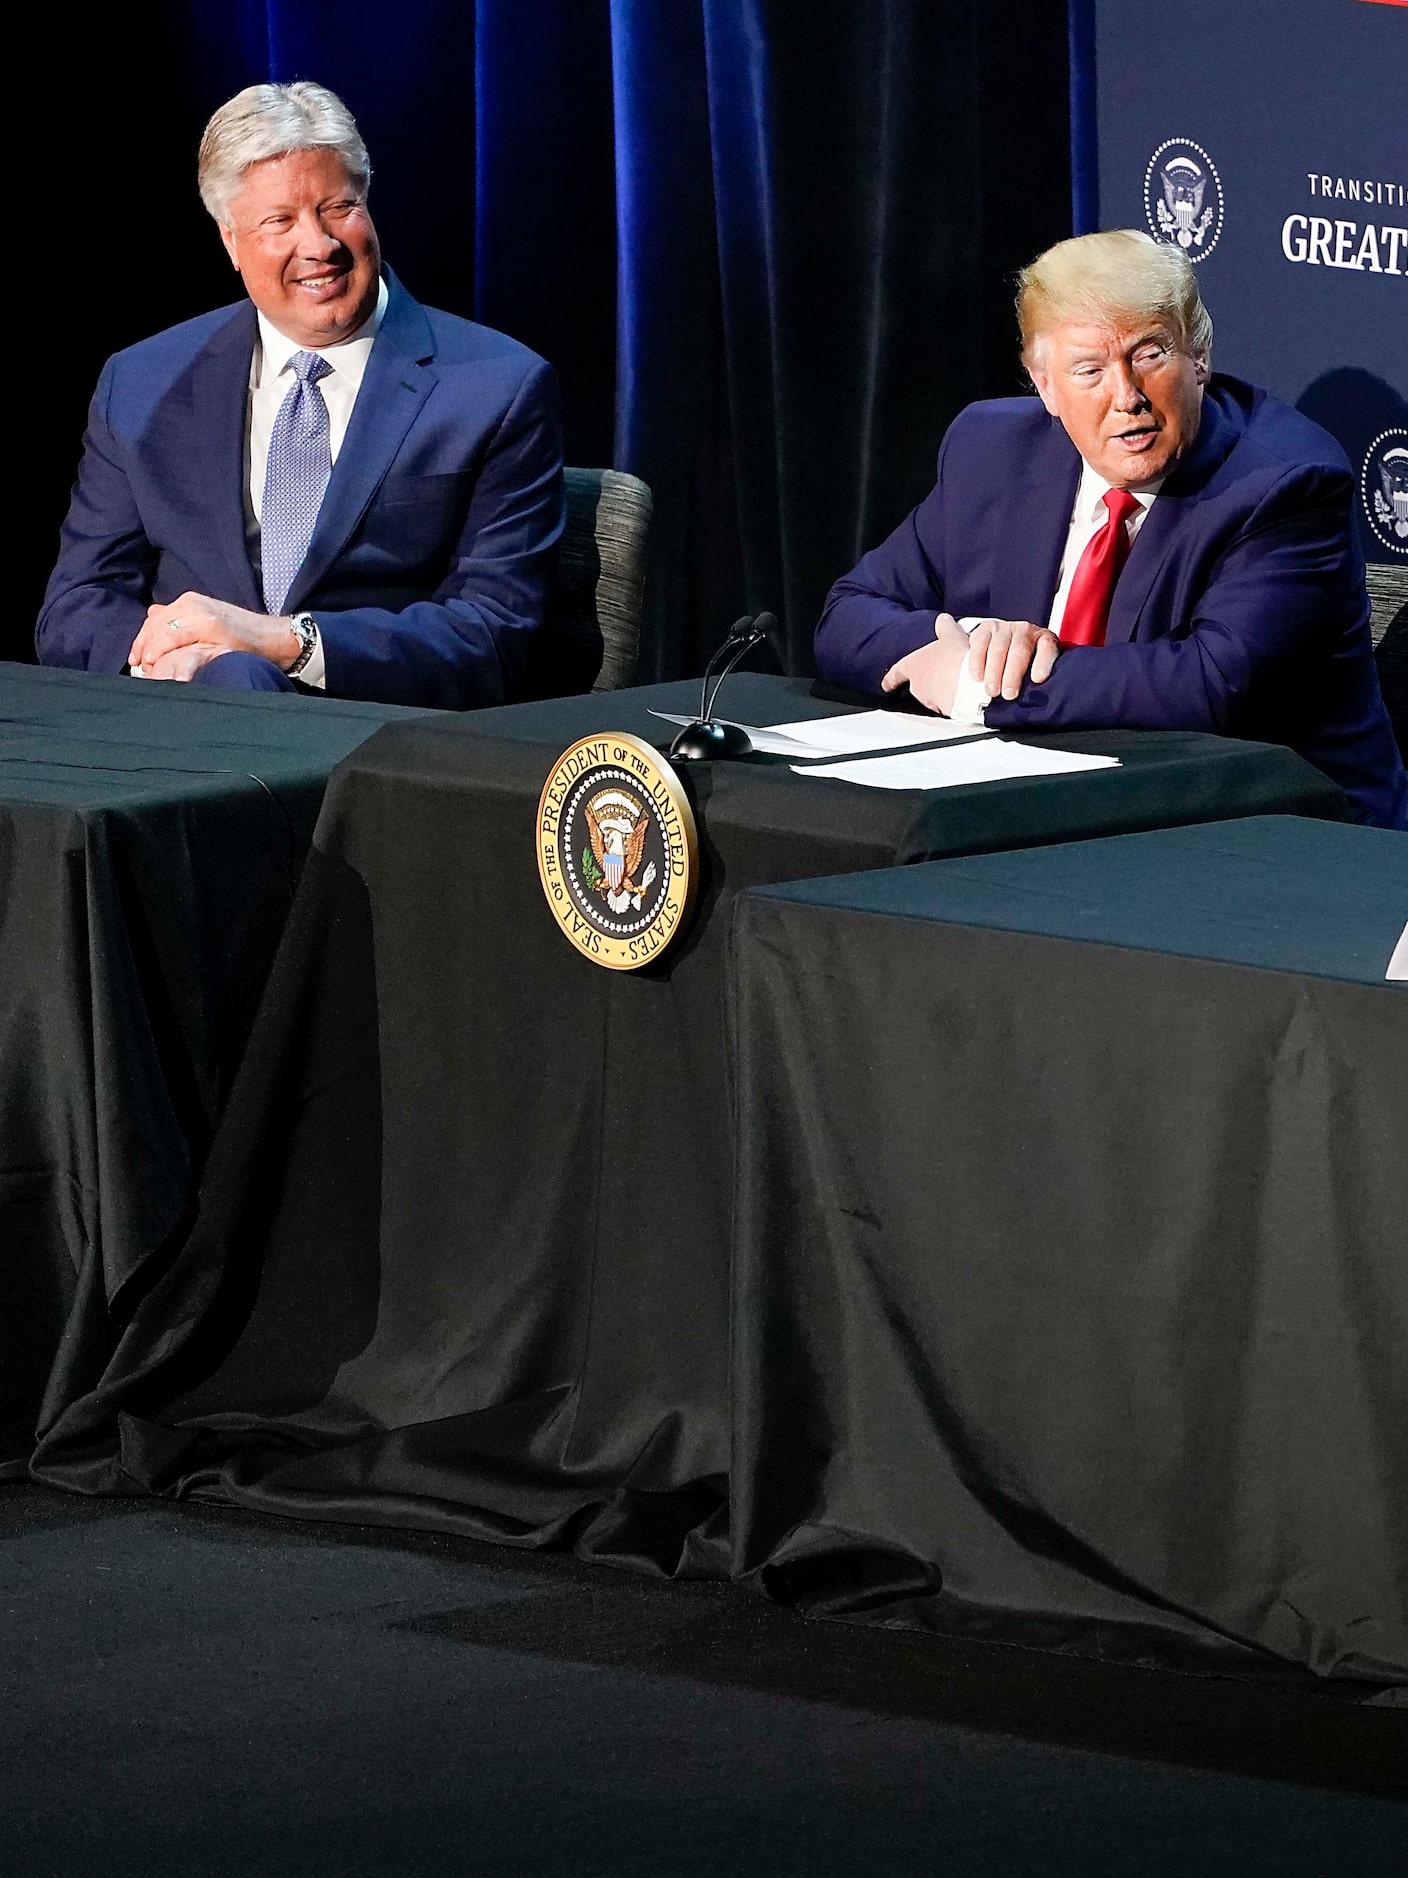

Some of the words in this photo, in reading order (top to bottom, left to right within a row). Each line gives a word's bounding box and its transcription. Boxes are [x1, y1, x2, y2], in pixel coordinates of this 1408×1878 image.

[613, 747, 628, 763] OF
[631, 754, 650, 779] THE
[543, 743, 609, 836] PRESIDENT
[651, 779, 685, 877] UNITED
[544, 844, 557, 876] THE
[551, 880, 564, 901] OF
[557, 900, 602, 954] SEAL
[628, 897, 679, 960] STATES
